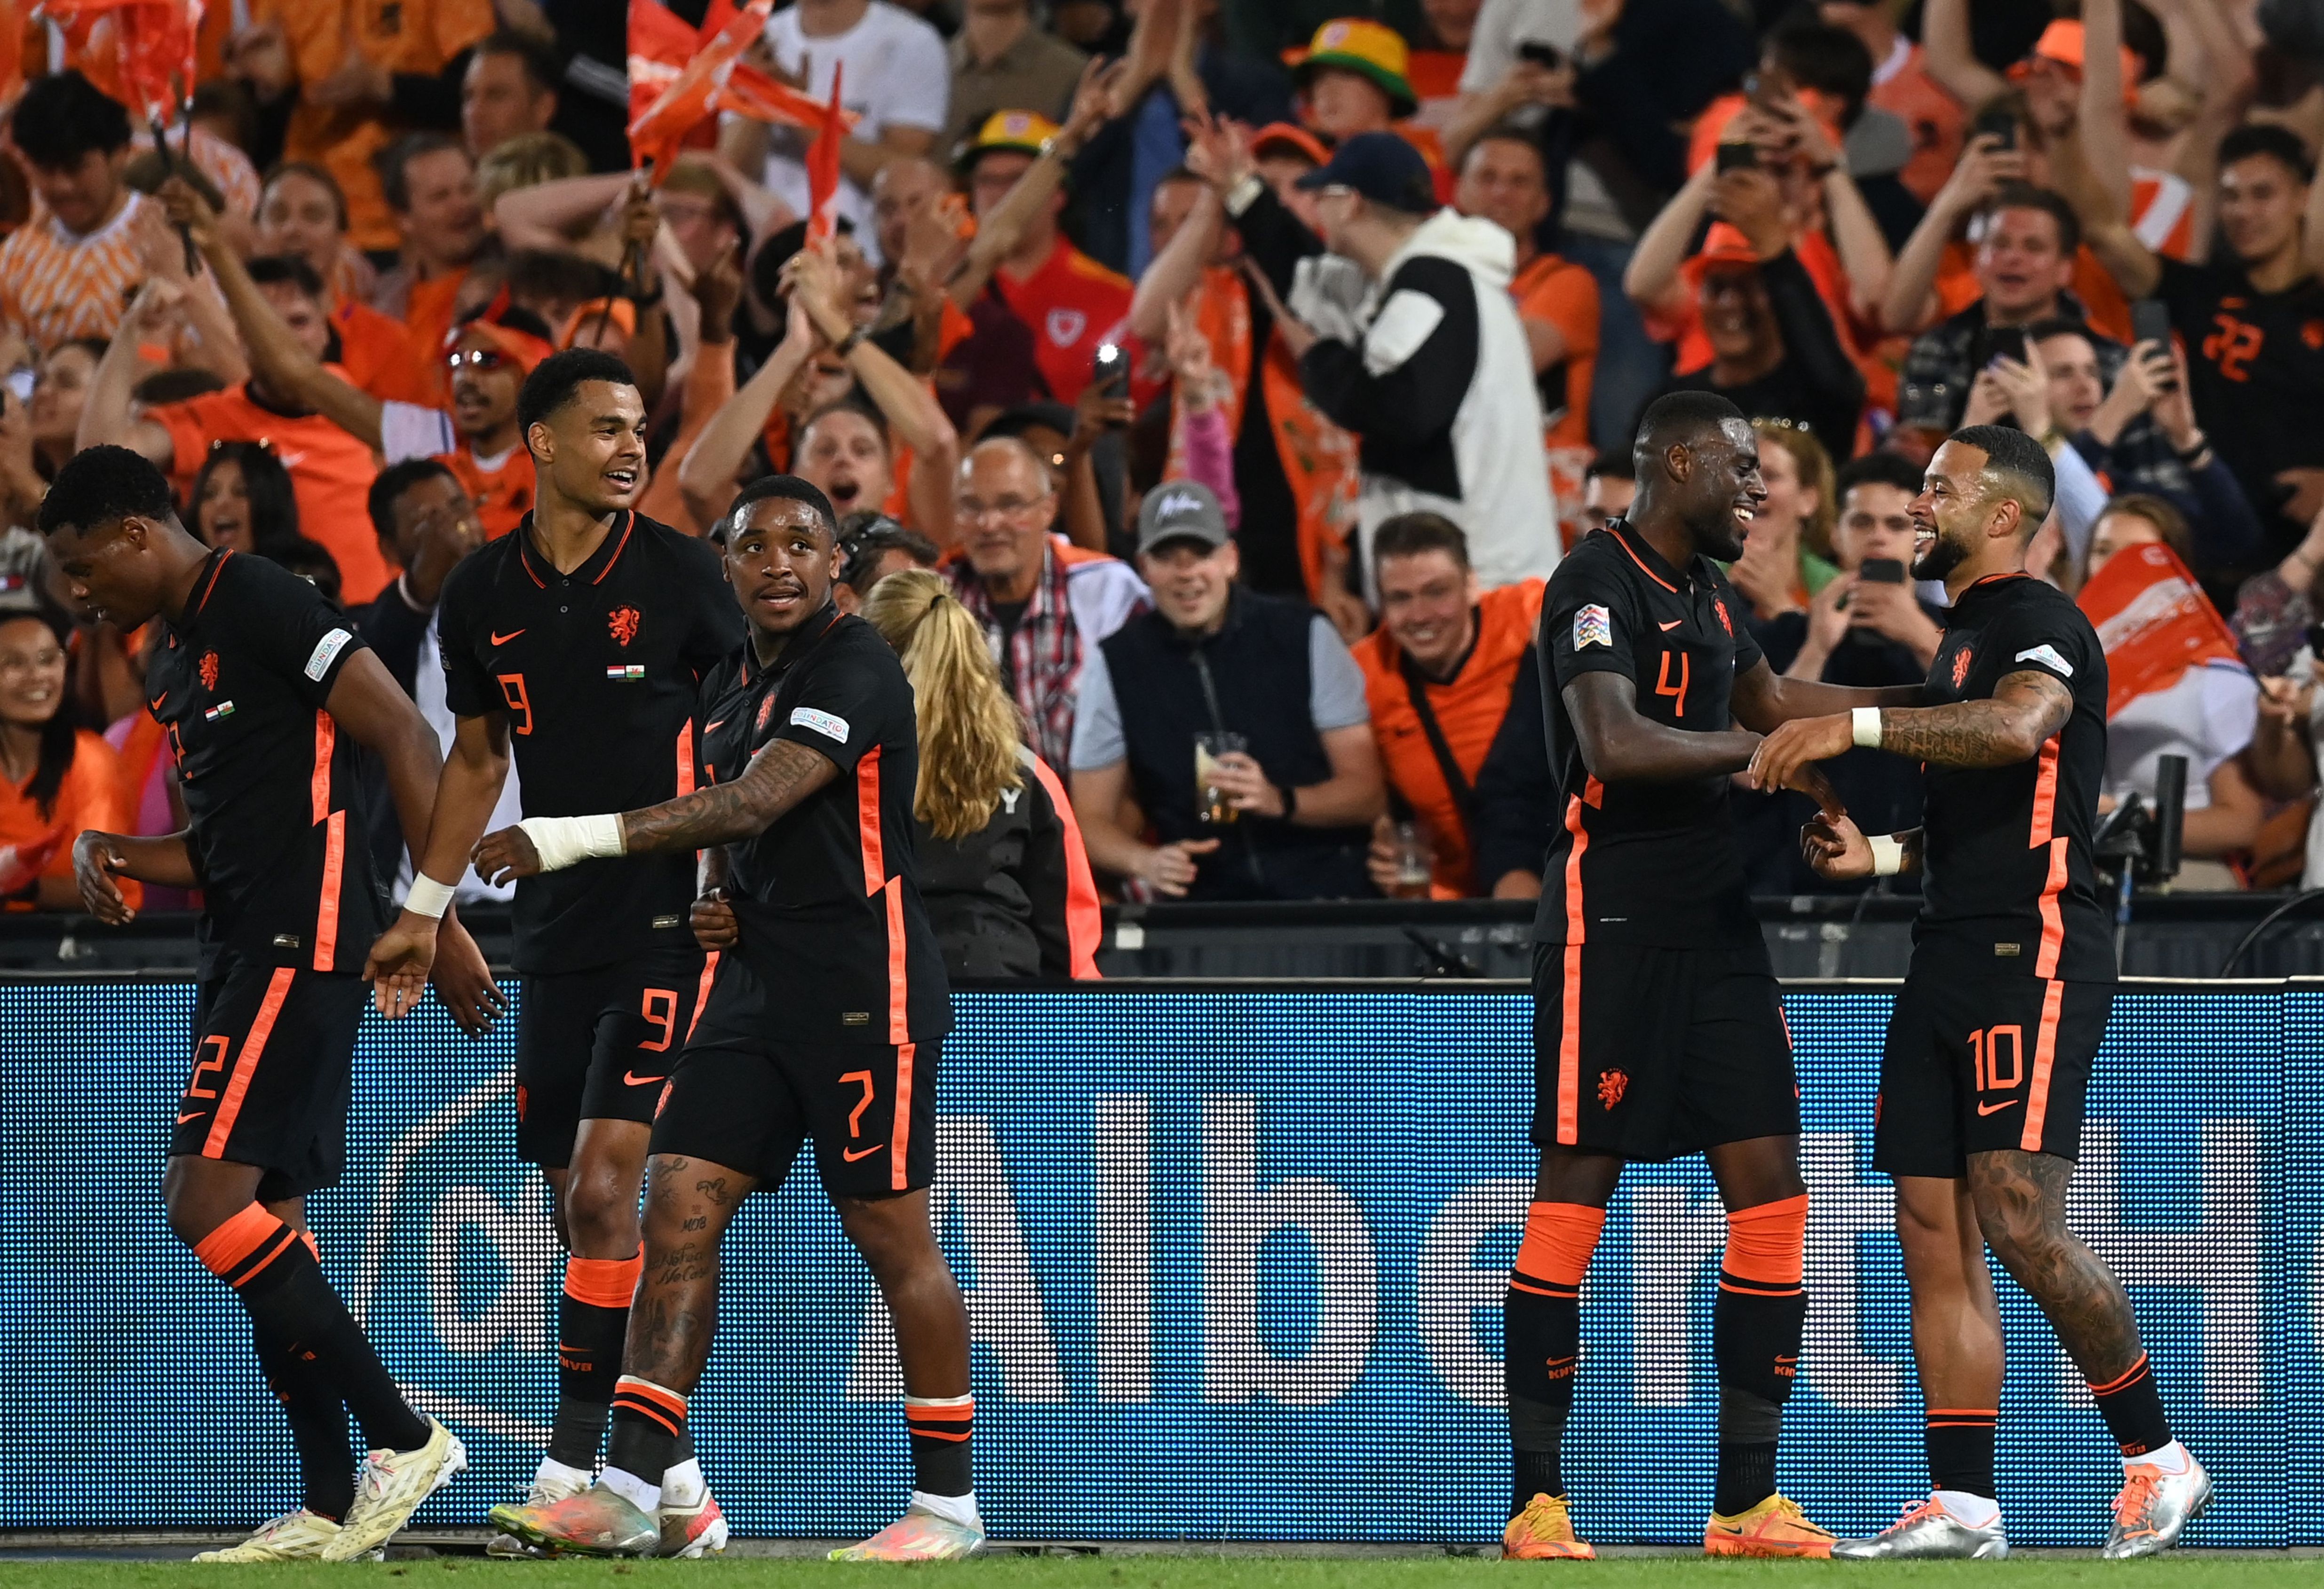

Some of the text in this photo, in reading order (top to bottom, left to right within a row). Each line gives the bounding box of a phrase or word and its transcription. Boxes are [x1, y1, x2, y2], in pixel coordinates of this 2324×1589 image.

[496, 673, 533, 735] 9
[1655, 650, 1689, 717] 4
[637, 988, 678, 1052] 9
[182, 1035, 230, 1099] 2
[1966, 1024, 2023, 1091] 10
[838, 1069, 874, 1138] 7
[845, 1091, 1905, 1409] Albert
[1548, 1365, 1576, 1380] KNV
